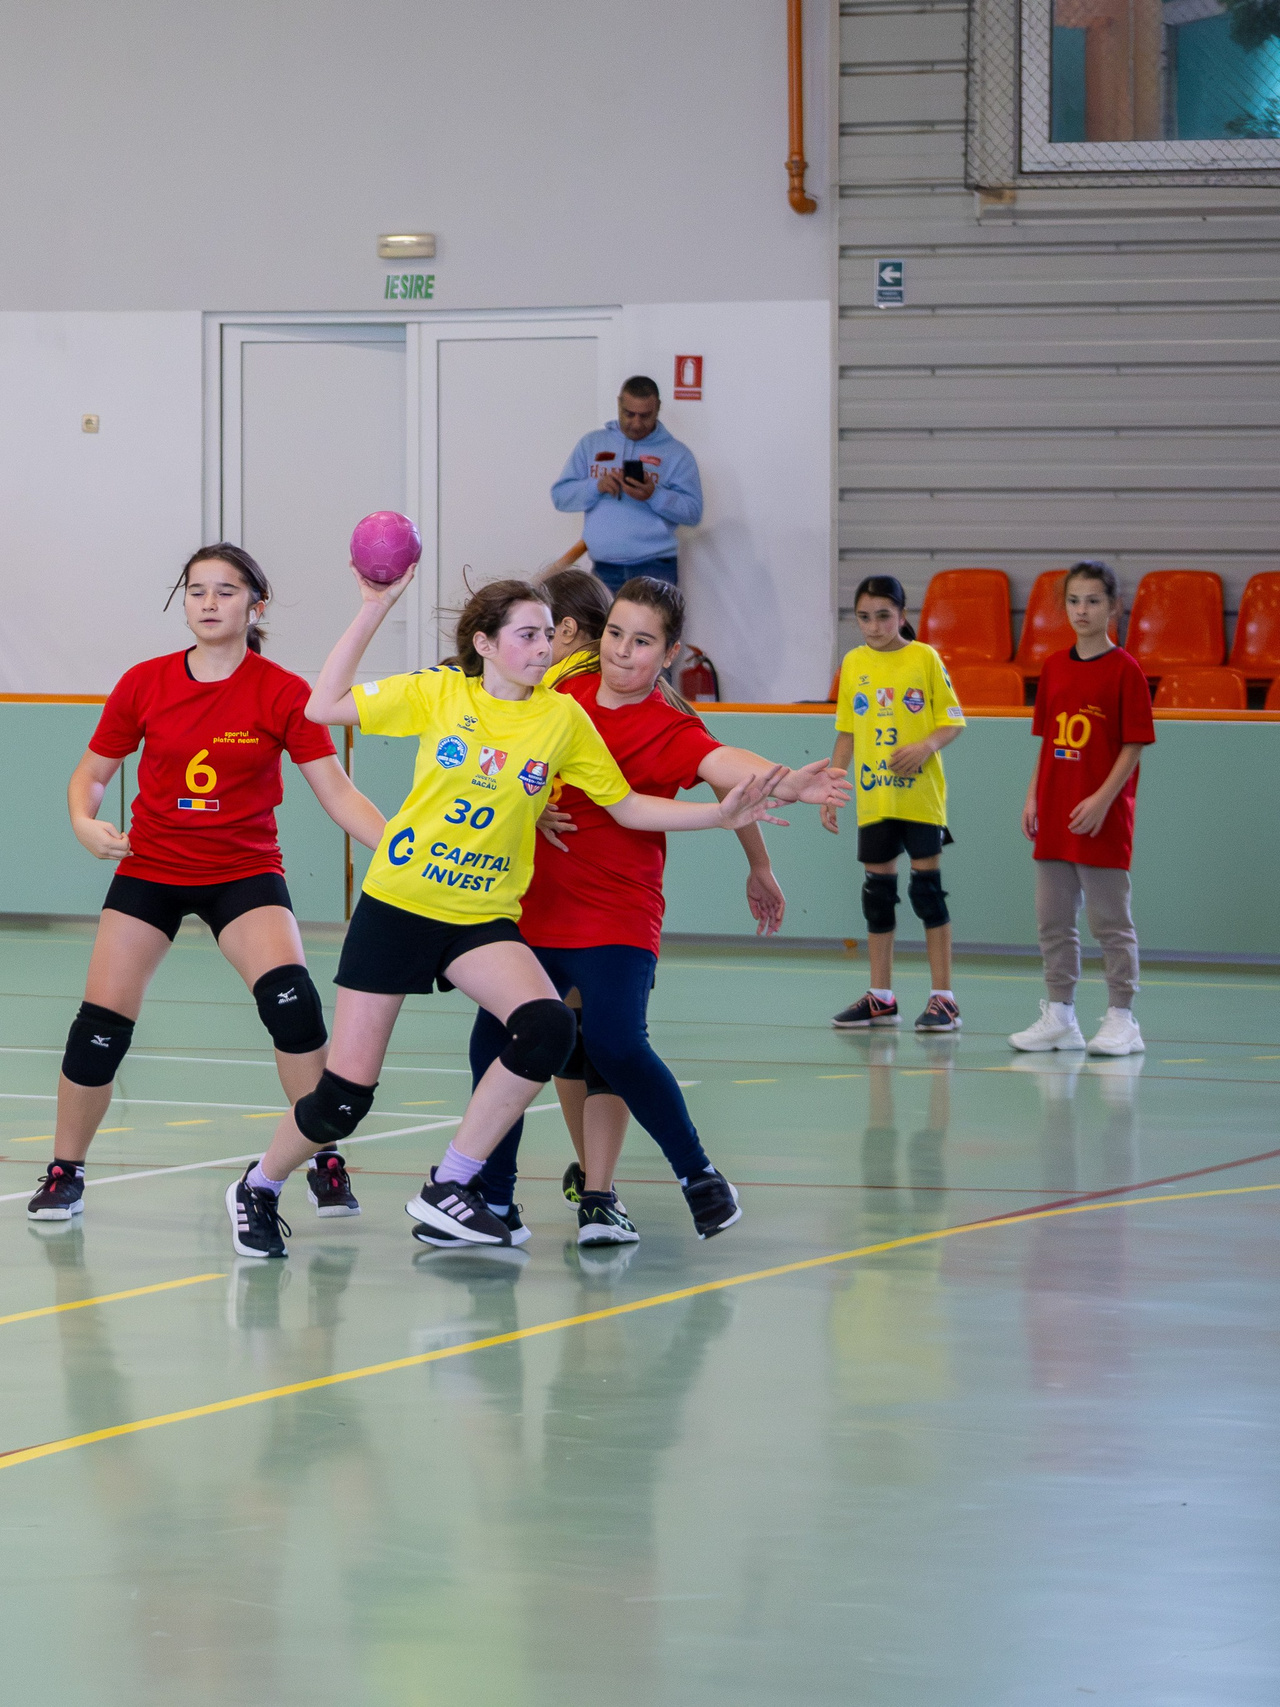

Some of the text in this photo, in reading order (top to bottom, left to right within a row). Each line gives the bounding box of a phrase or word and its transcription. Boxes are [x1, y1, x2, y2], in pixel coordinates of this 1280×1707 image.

[384, 274, 435, 299] IESIRE
[1053, 711, 1091, 749] 10
[185, 749, 218, 794] 6
[444, 798, 495, 829] 30
[430, 842, 510, 872] CAPITAL
[421, 862, 496, 892] INVEST
